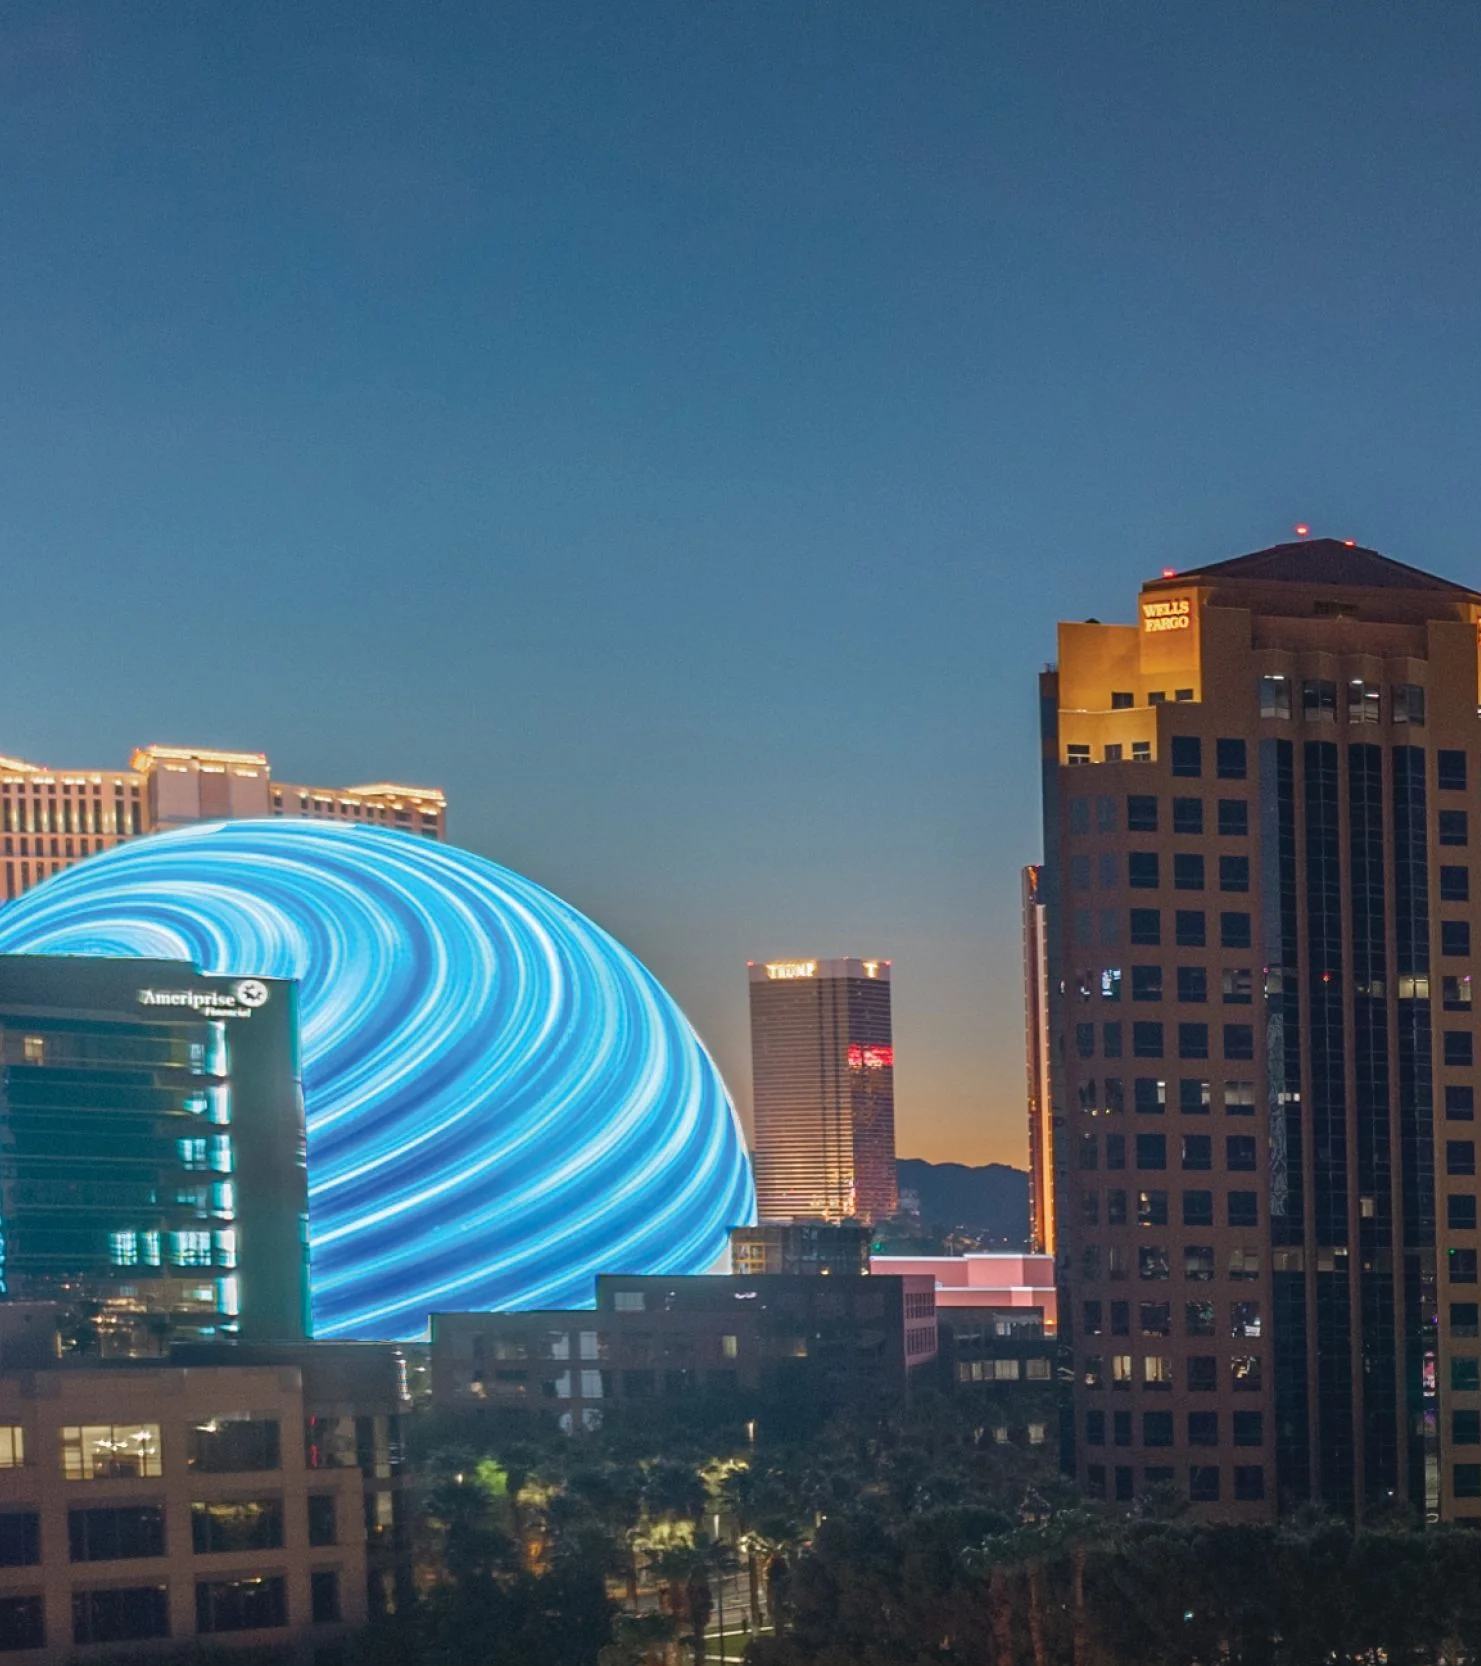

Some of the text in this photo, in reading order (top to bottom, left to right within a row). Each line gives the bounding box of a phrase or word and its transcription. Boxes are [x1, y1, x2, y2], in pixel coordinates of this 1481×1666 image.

[1143, 600, 1190, 618] WELLS
[1144, 615, 1190, 632] FARGO
[141, 988, 236, 1009] Ameriprise
